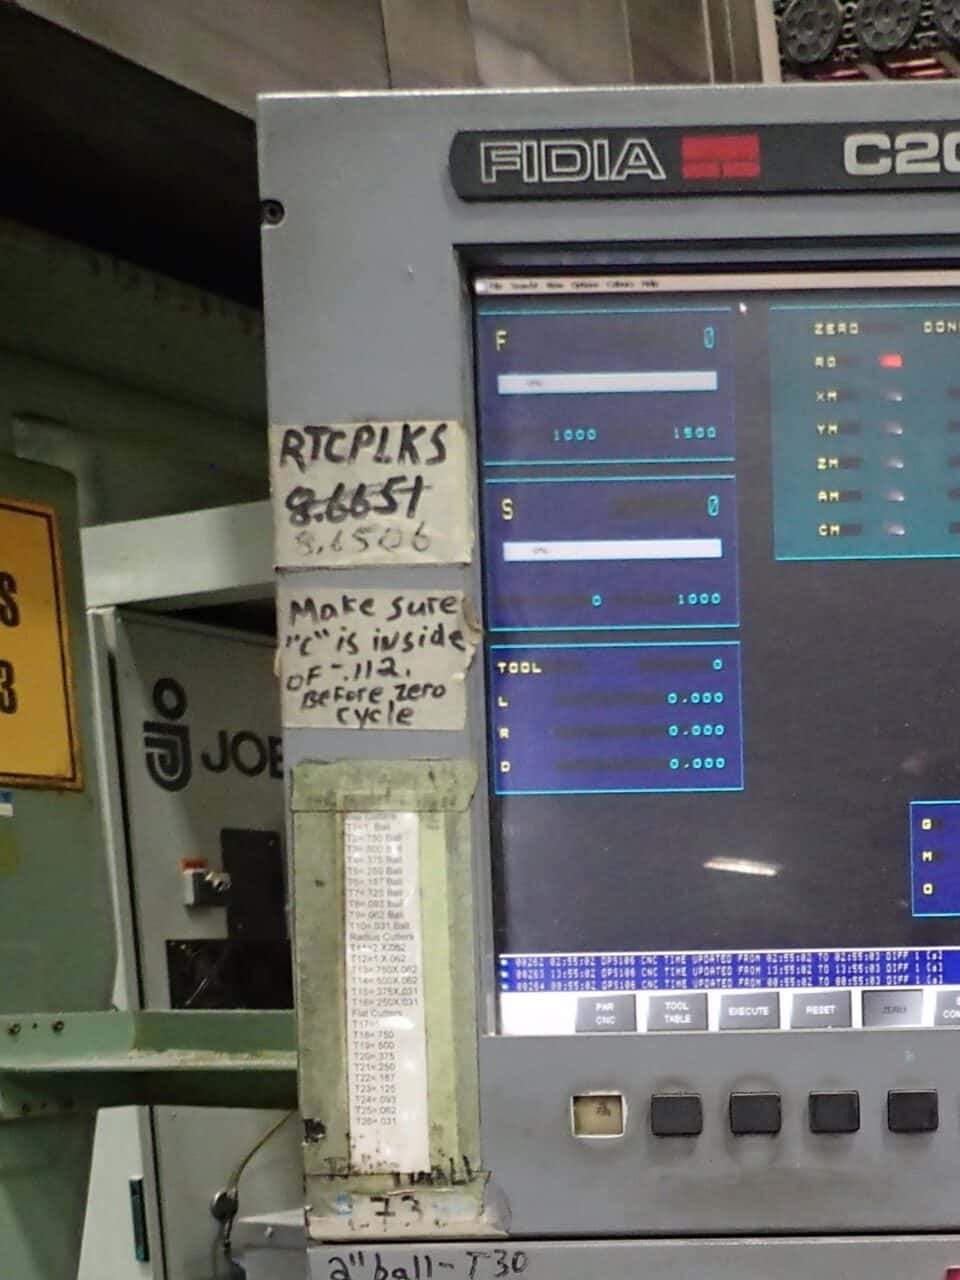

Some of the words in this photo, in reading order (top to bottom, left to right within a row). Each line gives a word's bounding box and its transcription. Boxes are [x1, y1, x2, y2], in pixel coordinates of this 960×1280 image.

[479, 138, 666, 183] FIDIA
[814, 322, 859, 335] ZERO
[496, 330, 506, 351] F
[554, 429, 597, 441] 1000
[674, 427, 716, 439] 1500
[817, 424, 838, 434] YM
[817, 457, 838, 470] ZM
[818, 491, 840, 501] AM
[502, 498, 513, 520] S
[818, 524, 840, 536] CM
[592, 595, 602, 606] 0
[678, 593, 721, 605] 1000
[289, 595, 375, 626] Make
[336, 626, 359, 655] is
[498, 662, 542, 673] TOOL
[713, 658, 722, 670] 0
[498, 696, 508, 707] L
[667, 692, 724, 704] 0.000
[668, 724, 724, 736] 0.000
[669, 757, 725, 769] 0.000
[923, 850, 932, 862] M
[665, 1002, 688, 1010] TOOL
[728, 1007, 769, 1016] EXECUTE
[806, 1005, 836, 1014] RESET
[665, 1015, 691, 1023] TABLE
